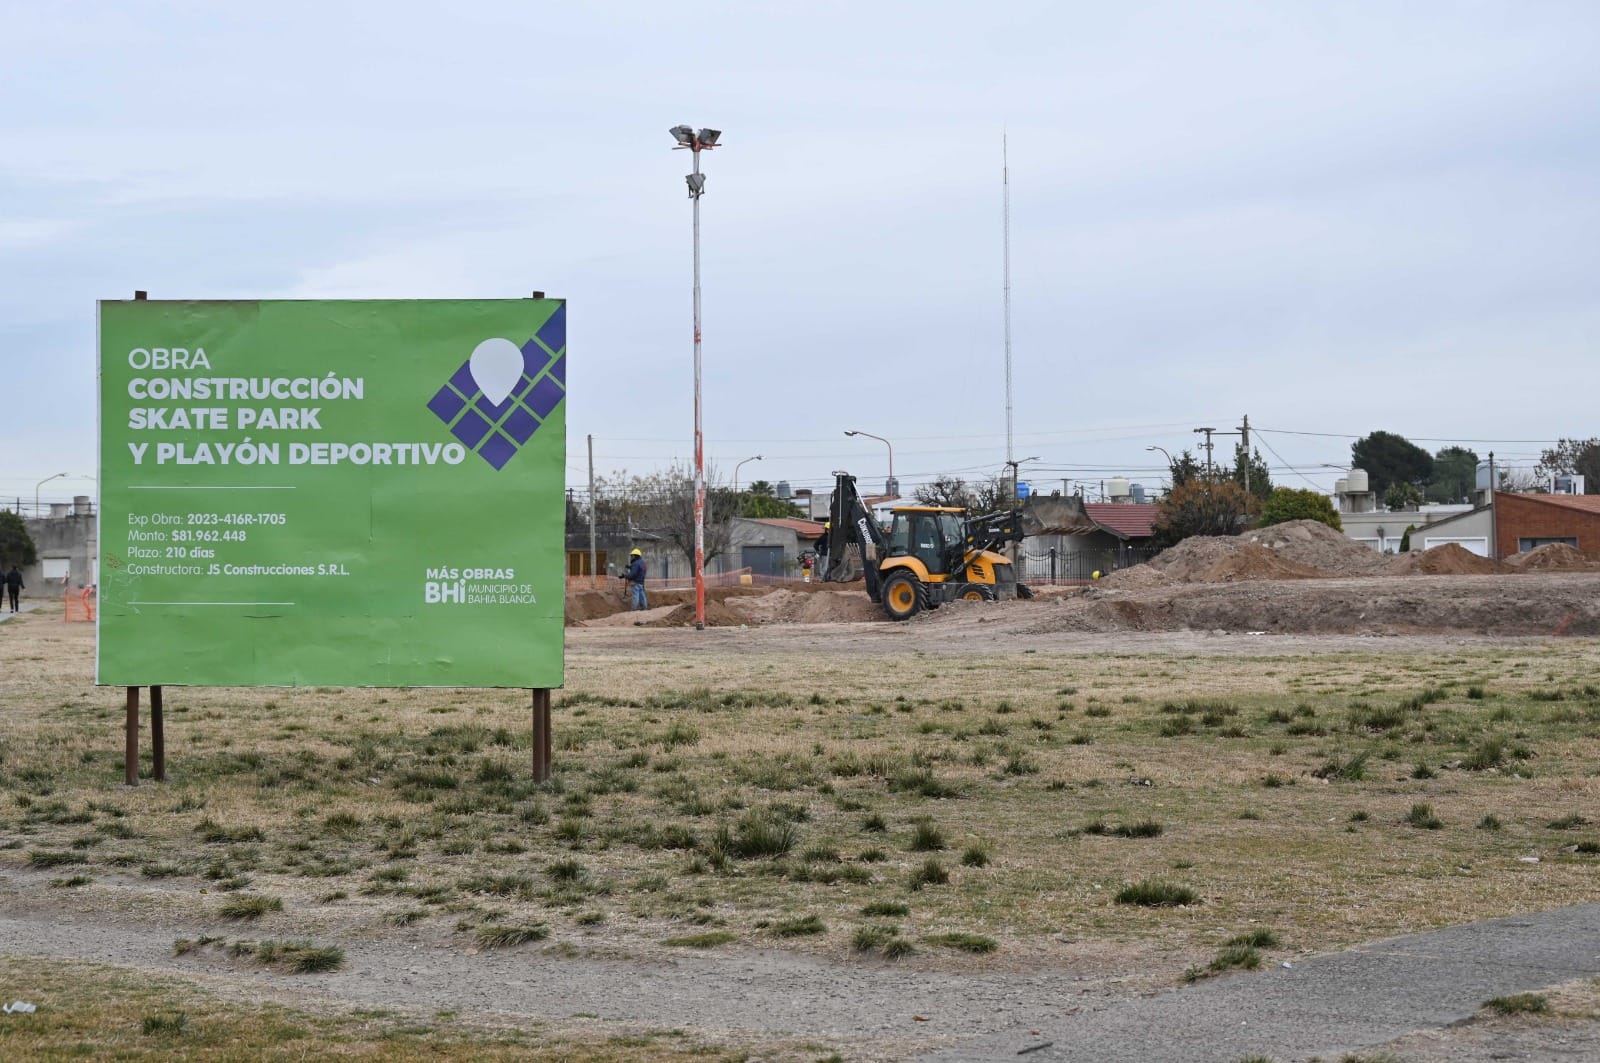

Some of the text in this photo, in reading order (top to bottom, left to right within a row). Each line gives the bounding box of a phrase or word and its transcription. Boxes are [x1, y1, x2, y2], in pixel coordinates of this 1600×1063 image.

[128, 347, 212, 370] OBRA
[127, 370, 364, 400] CONSTRUCCIÓN
[127, 407, 322, 430] SKATE PARK
[127, 436, 466, 465] Y PLAYÓN DEPORTIVO
[128, 513, 287, 528] Exp Obra: 2023-416R-1705
[127, 529, 247, 543] Monto: $81.962.448
[127, 546, 216, 559] Plazo: 210 días
[127, 563, 350, 576] Constructora: JS Construcciones S.R.L.
[426, 565, 515, 580] MÁS OBRAS
[468, 584, 533, 594] MUNICIPIO DE
[499, 594, 537, 604] BLANCA
